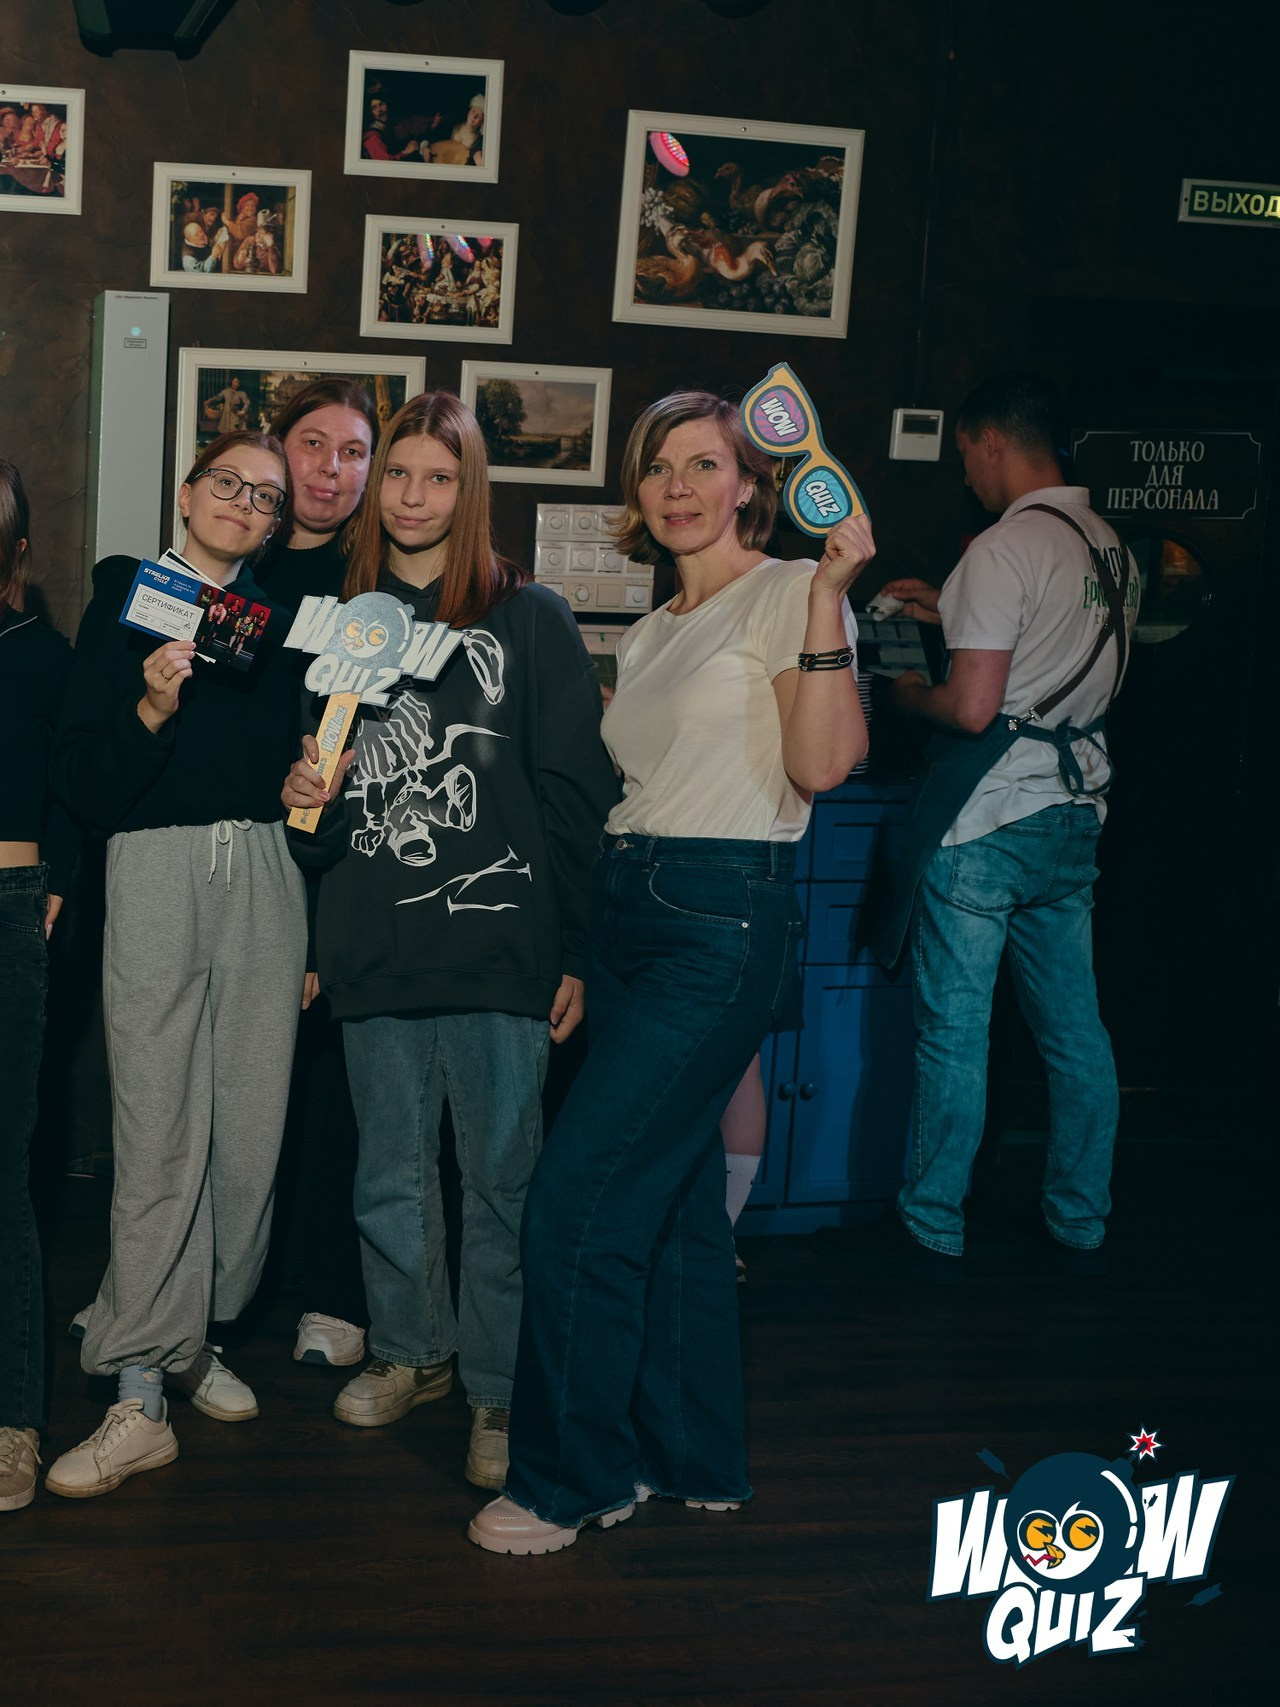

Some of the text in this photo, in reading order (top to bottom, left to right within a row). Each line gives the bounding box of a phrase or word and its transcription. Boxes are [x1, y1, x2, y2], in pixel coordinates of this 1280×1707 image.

[1193, 190, 1280, 218] ВЫХОД
[760, 396, 799, 438] WOW
[1130, 440, 1205, 463] ТОЛЬКО
[1144, 464, 1184, 488] ДЛЯ
[804, 480, 842, 518] QUIZ
[1107, 487, 1220, 511] ПЕРСОНАЛА
[141, 593, 195, 619] СЕРТИФИКАТ
[284, 592, 465, 681] WOW
[305, 655, 403, 706] QUIZ
